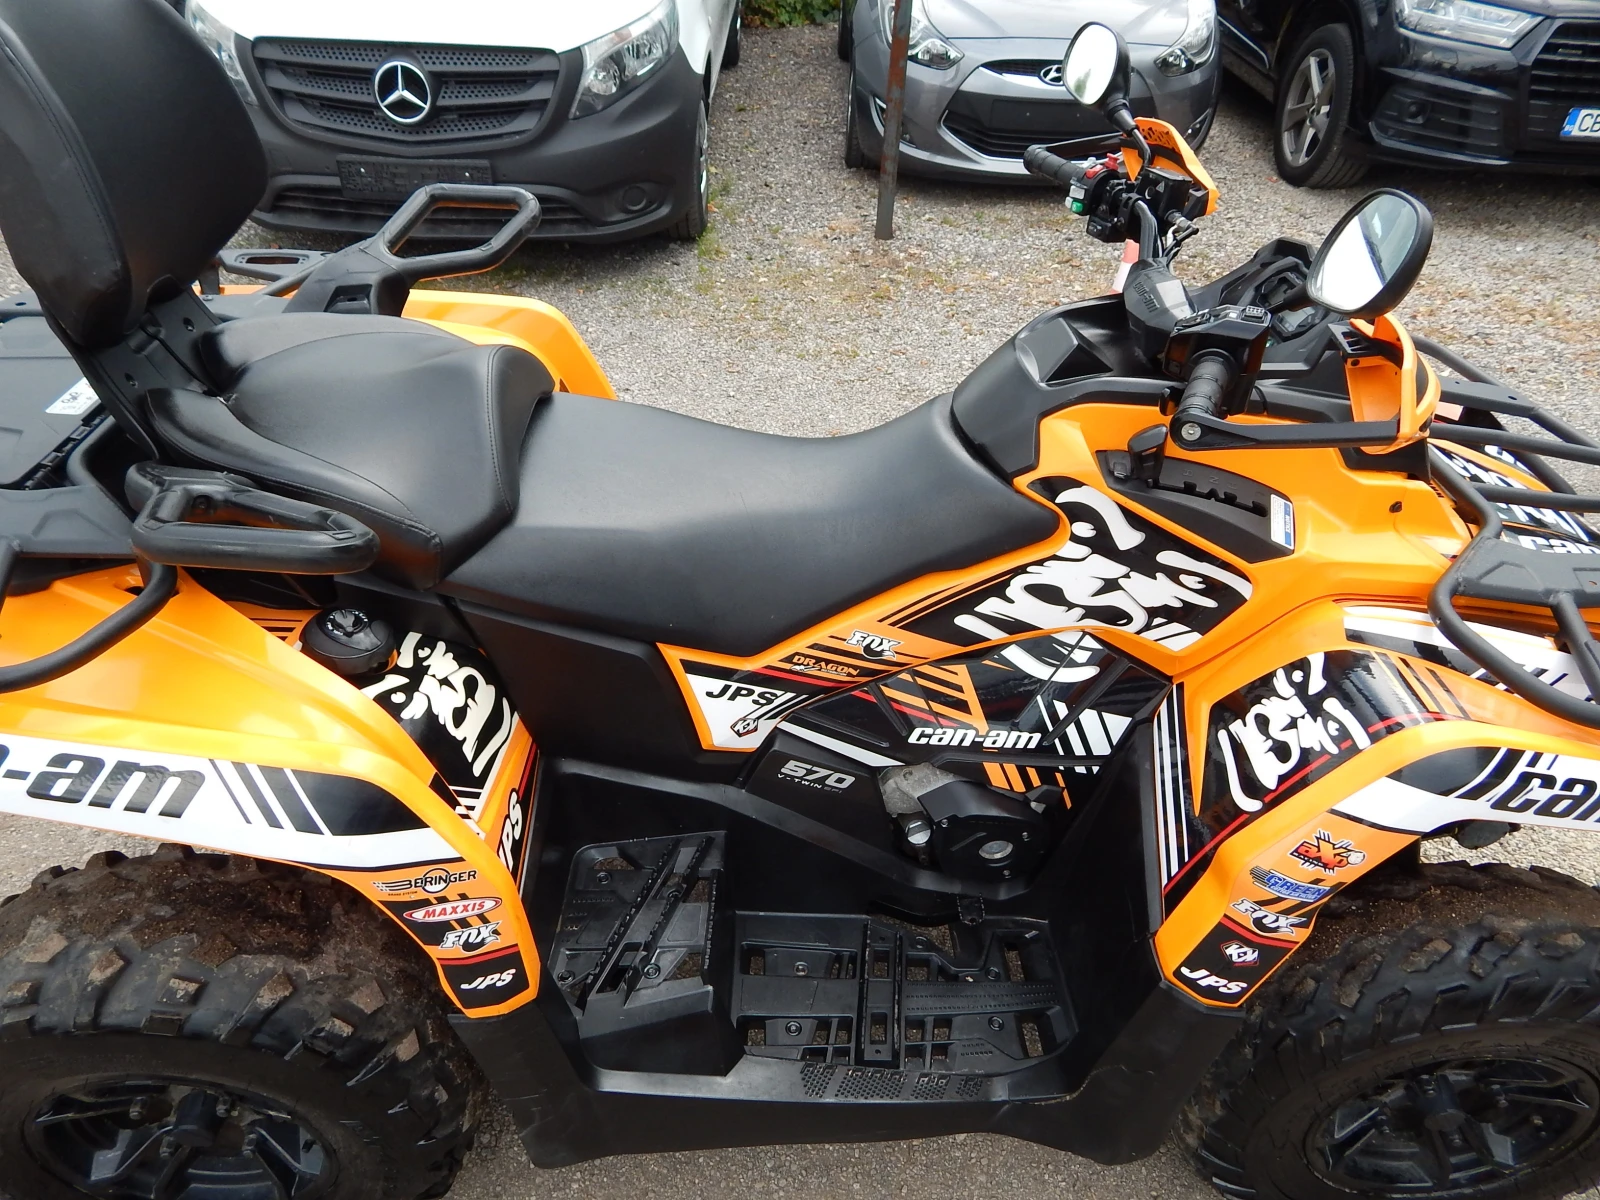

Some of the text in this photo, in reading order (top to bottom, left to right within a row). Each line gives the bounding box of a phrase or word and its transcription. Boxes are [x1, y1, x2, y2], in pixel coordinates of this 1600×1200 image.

[844, 629, 904, 660] FOX
[792, 655, 860, 676] DRAGON
[705, 683, 778, 706] JPS
[907, 727, 1041, 749] can-am
[777, 773, 823, 789] V-TWIN
[780, 759, 856, 789] 570
[380, 869, 477, 893] BERINGER
[1265, 873, 1329, 896] GREEN
[421, 900, 486, 919] MAXXIS
[1230, 898, 1308, 936] FOX
[439, 920, 503, 954] FOX
[460, 968, 517, 990] JPS
[1180, 966, 1248, 994] JPS
